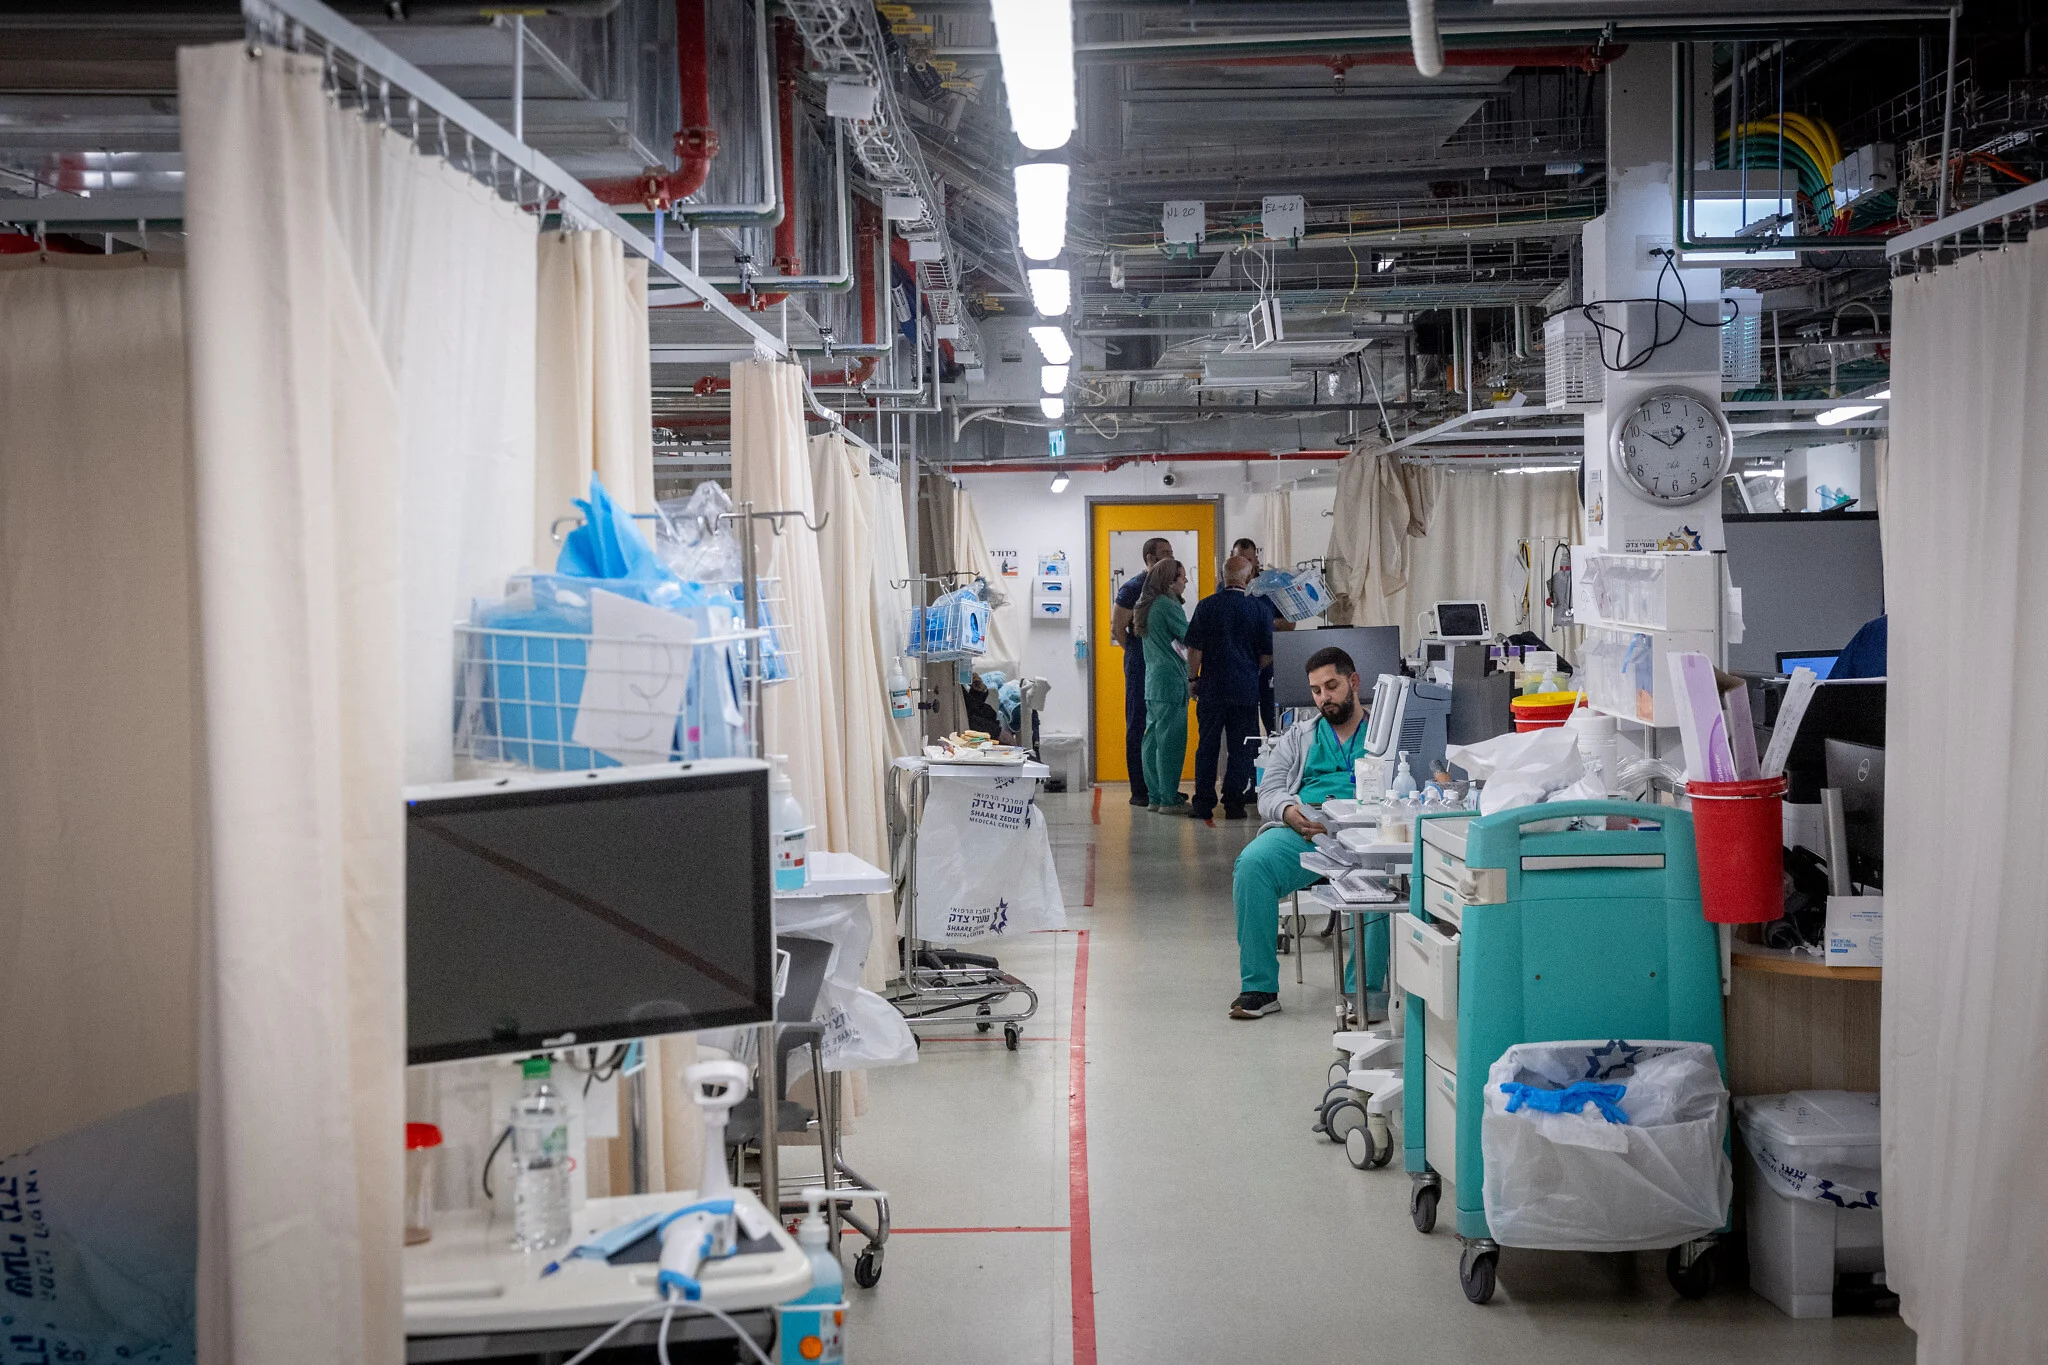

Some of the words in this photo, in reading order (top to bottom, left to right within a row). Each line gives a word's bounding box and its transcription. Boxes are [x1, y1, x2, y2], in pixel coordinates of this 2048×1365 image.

[1661, 402, 1671, 414] 12
[1684, 405, 1688, 416] 1
[1642, 409, 1650, 421] 11
[1697, 416, 1704, 428] 2
[1629, 426, 1640, 437] 10
[1706, 436, 1713, 448] 3
[1629, 446, 1636, 457] 9
[1703, 457, 1710, 468] 4
[1637, 465, 1644, 477] 8
[1653, 477, 1659, 489] 7
[1690, 473, 1697, 484] 5
[1672, 480, 1679, 492] 6
[974, 793, 999, 801] הרפואי
[1002, 797, 1024, 805] המרכז
[971, 798, 995, 809] צדק
[997, 803, 1023, 815] שערי
[969, 817, 996, 827] MEDICAL
[970, 810, 998, 820] SHAARE
[1000, 815, 1020, 824] ZEDEK
[948, 913, 970, 923] צדק
[947, 924, 972, 932] SHAARE
